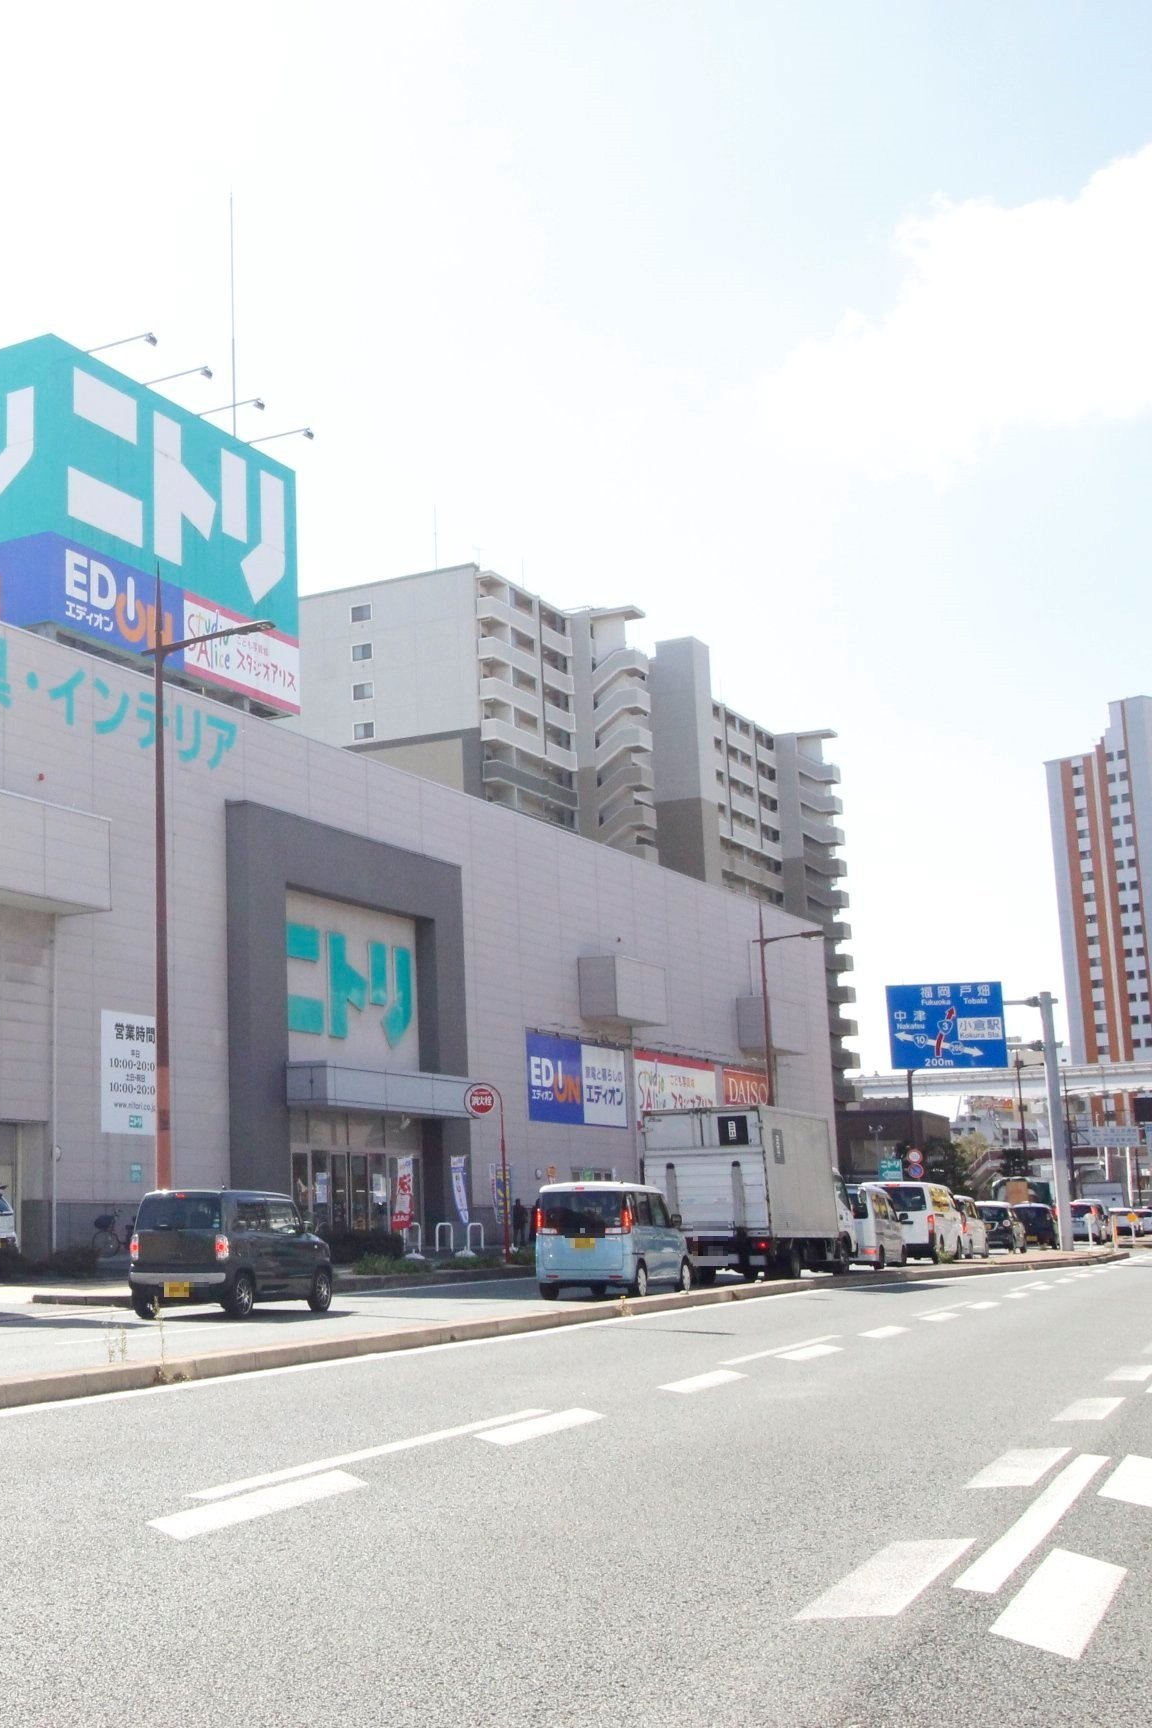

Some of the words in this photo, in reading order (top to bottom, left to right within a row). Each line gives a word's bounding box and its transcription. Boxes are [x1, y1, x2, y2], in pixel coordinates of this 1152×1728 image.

[68, 367, 285, 604] ニトリ
[65, 549, 174, 657] EDION
[65, 601, 114, 632] エディオン
[237, 648, 296, 692] スタジオアリス
[286, 922, 412, 1048] ニトリ
[920, 985, 950, 998] 福岡
[960, 984, 991, 997] 戸畑
[894, 1010, 926, 1021] 中津
[942, 1022, 949, 1030] 3
[959, 1018, 1000, 1031] 小倉駅
[114, 1023, 155, 1044] 営業時間
[915, 1035, 925, 1043] 10
[110, 1058, 155, 1071] 10:00-20:0
[925, 1058, 954, 1067] 200m
[530, 1056, 580, 1104] EDION
[110, 1082, 155, 1096] 10:00-20:0
[532, 1089, 554, 1101] エディオン
[586, 1085, 623, 1106] エディオン
[728, 1077, 768, 1105] DAISO
[114, 1101, 155, 1112] www.nitori.co.j
[471, 1095, 493, 1106] 消火栓
